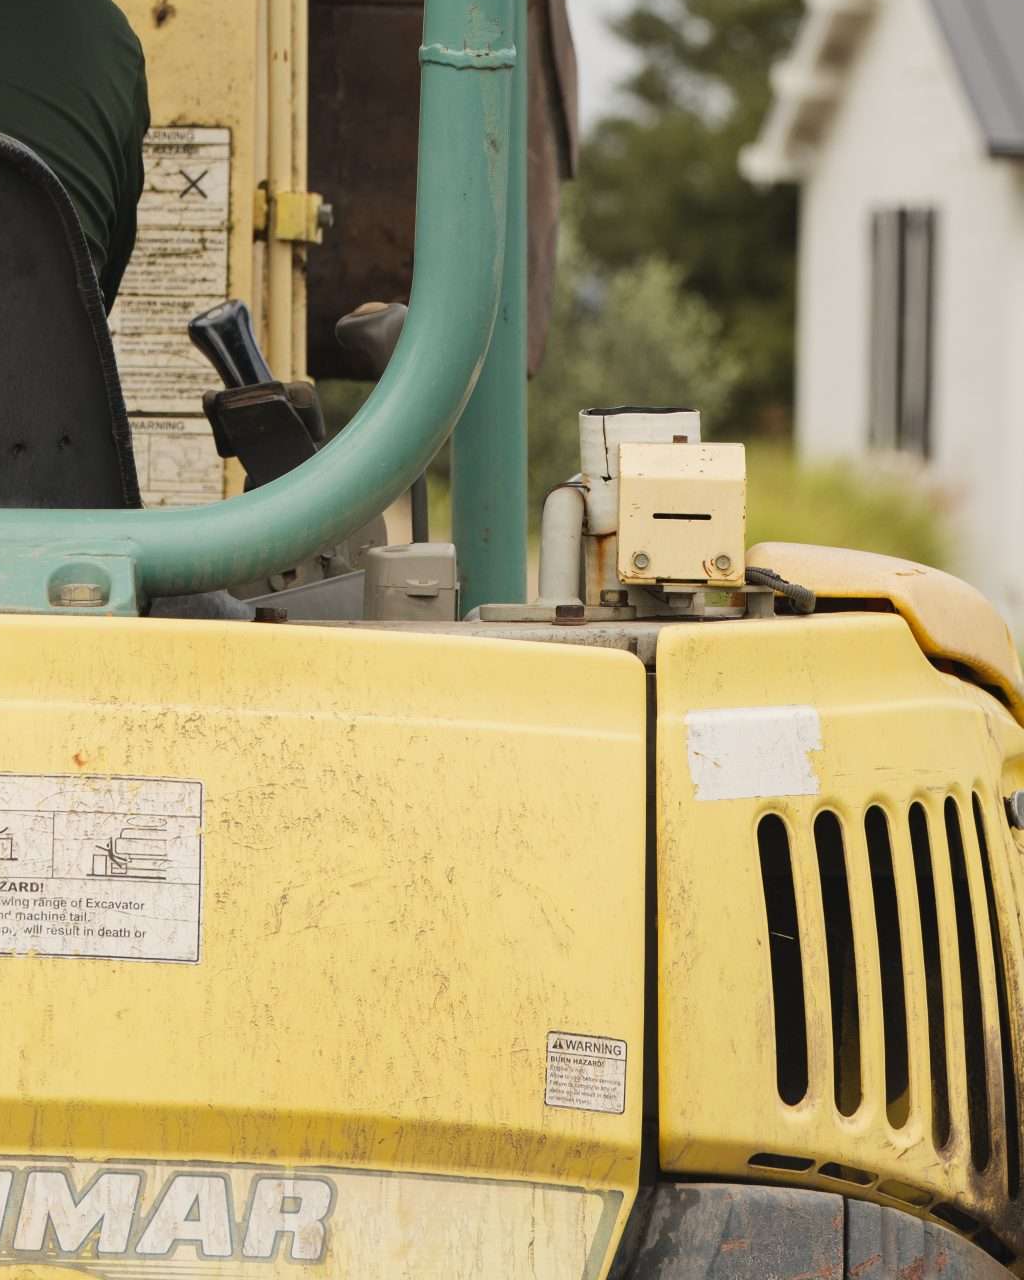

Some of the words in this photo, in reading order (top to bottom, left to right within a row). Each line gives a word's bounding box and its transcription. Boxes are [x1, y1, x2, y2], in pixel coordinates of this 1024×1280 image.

[145, 128, 195, 141] ARNING
[33, 898, 67, 910] range
[70, 898, 82, 909] of
[86, 898, 145, 911] Excavator
[23, 924, 43, 935] will
[83, 926, 94, 937] in
[97, 926, 130, 938] death
[134, 929, 147, 939] or
[565, 1039, 622, 1056] WARNING
